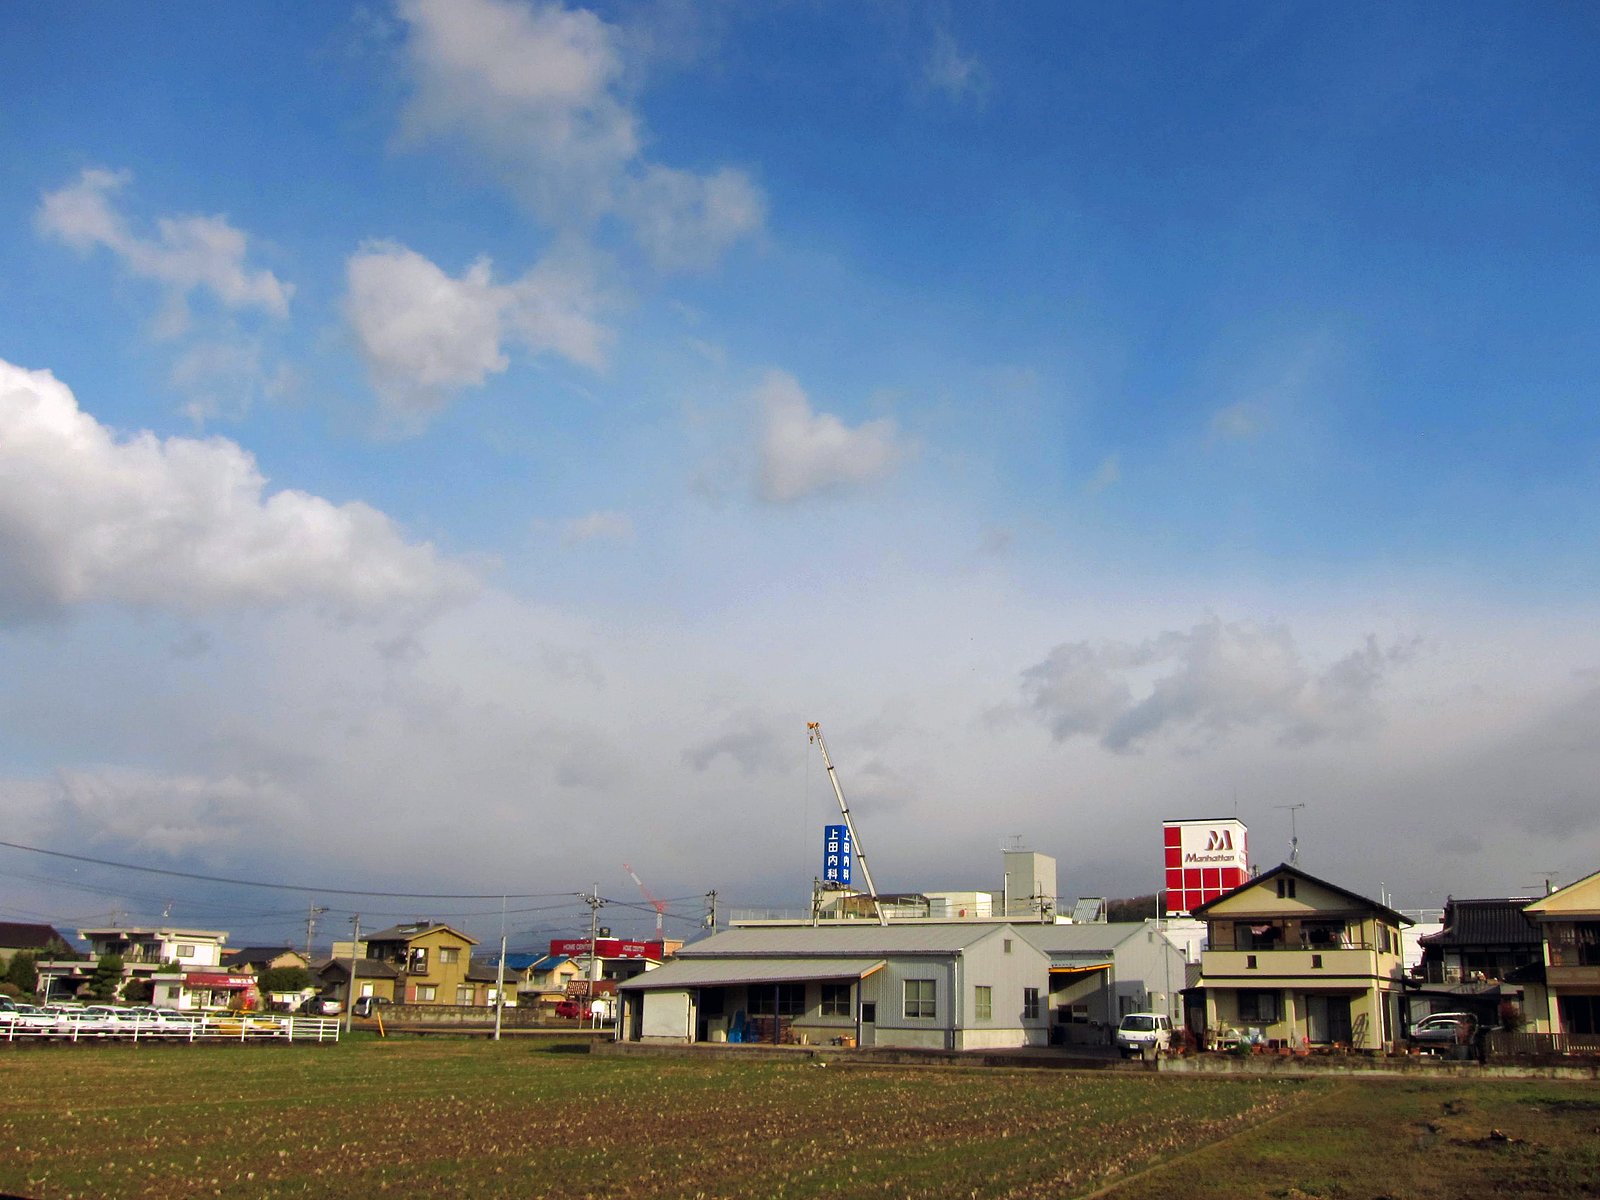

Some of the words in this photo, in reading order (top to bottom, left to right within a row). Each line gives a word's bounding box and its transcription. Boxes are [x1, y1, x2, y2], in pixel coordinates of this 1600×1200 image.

[827, 828, 838, 880] 上田内科
[1185, 853, 1234, 862] Manhattan
[563, 943, 576, 951] HOME
[576, 943, 593, 951] CENTE
